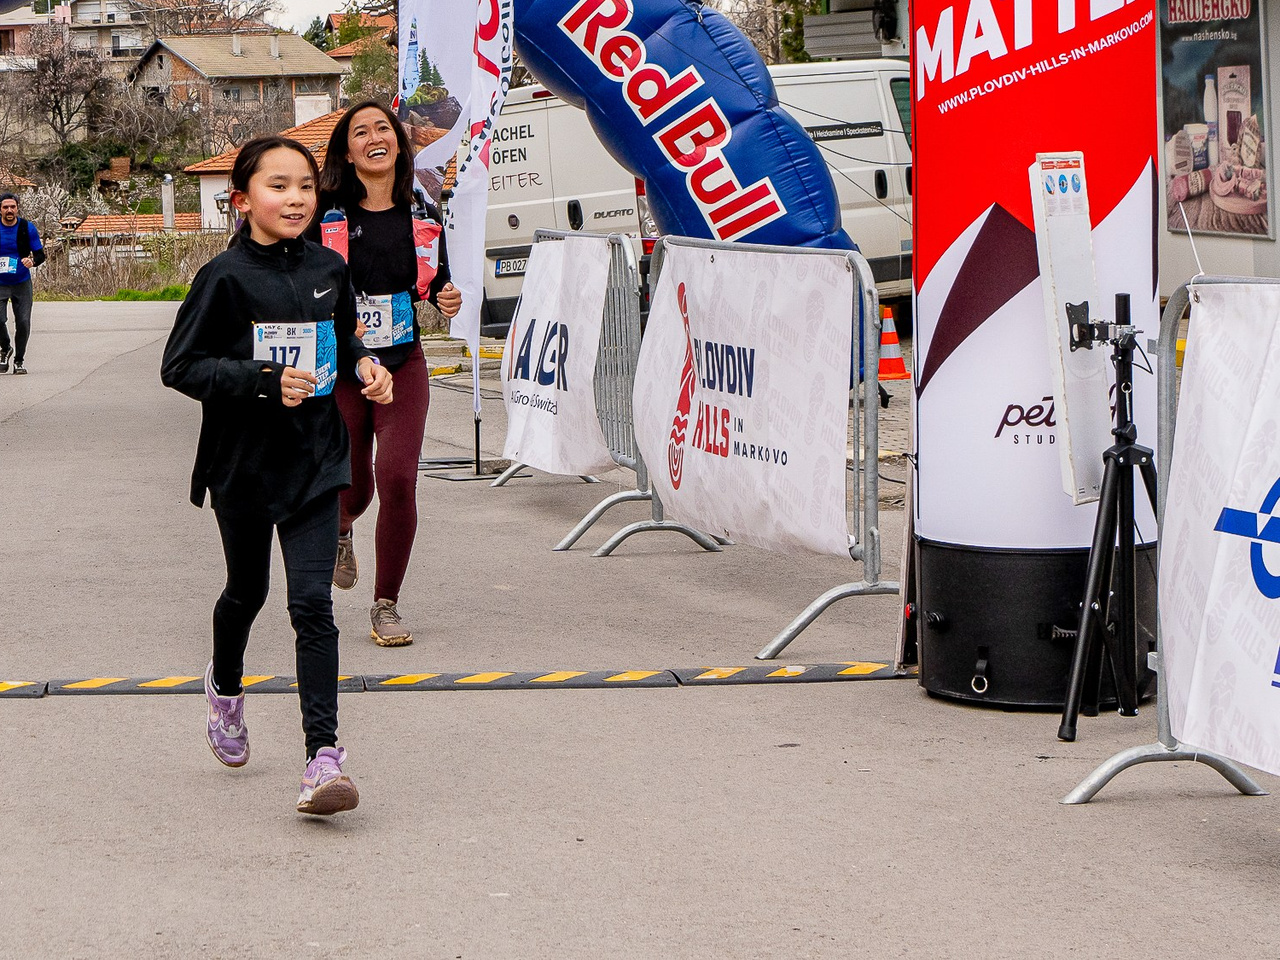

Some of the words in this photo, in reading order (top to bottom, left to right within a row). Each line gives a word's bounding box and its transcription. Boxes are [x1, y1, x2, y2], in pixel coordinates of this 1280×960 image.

[1182, 28, 1238, 42] www.nashensko.bg
[938, 10, 1154, 114] WWW.PLOVDIV-HILLS-IN-MARKOVO.COM
[492, 147, 527, 165] ÖFEN
[657, 102, 783, 241] Bull
[488, 171, 543, 192] EITER
[594, 208, 634, 220] DUCATO
[501, 261, 511, 272] PB
[287, 327, 297, 336] 8K
[269, 346, 301, 368] 117
[733, 416, 743, 434] IN
[733, 440, 788, 466] MARKOVO
